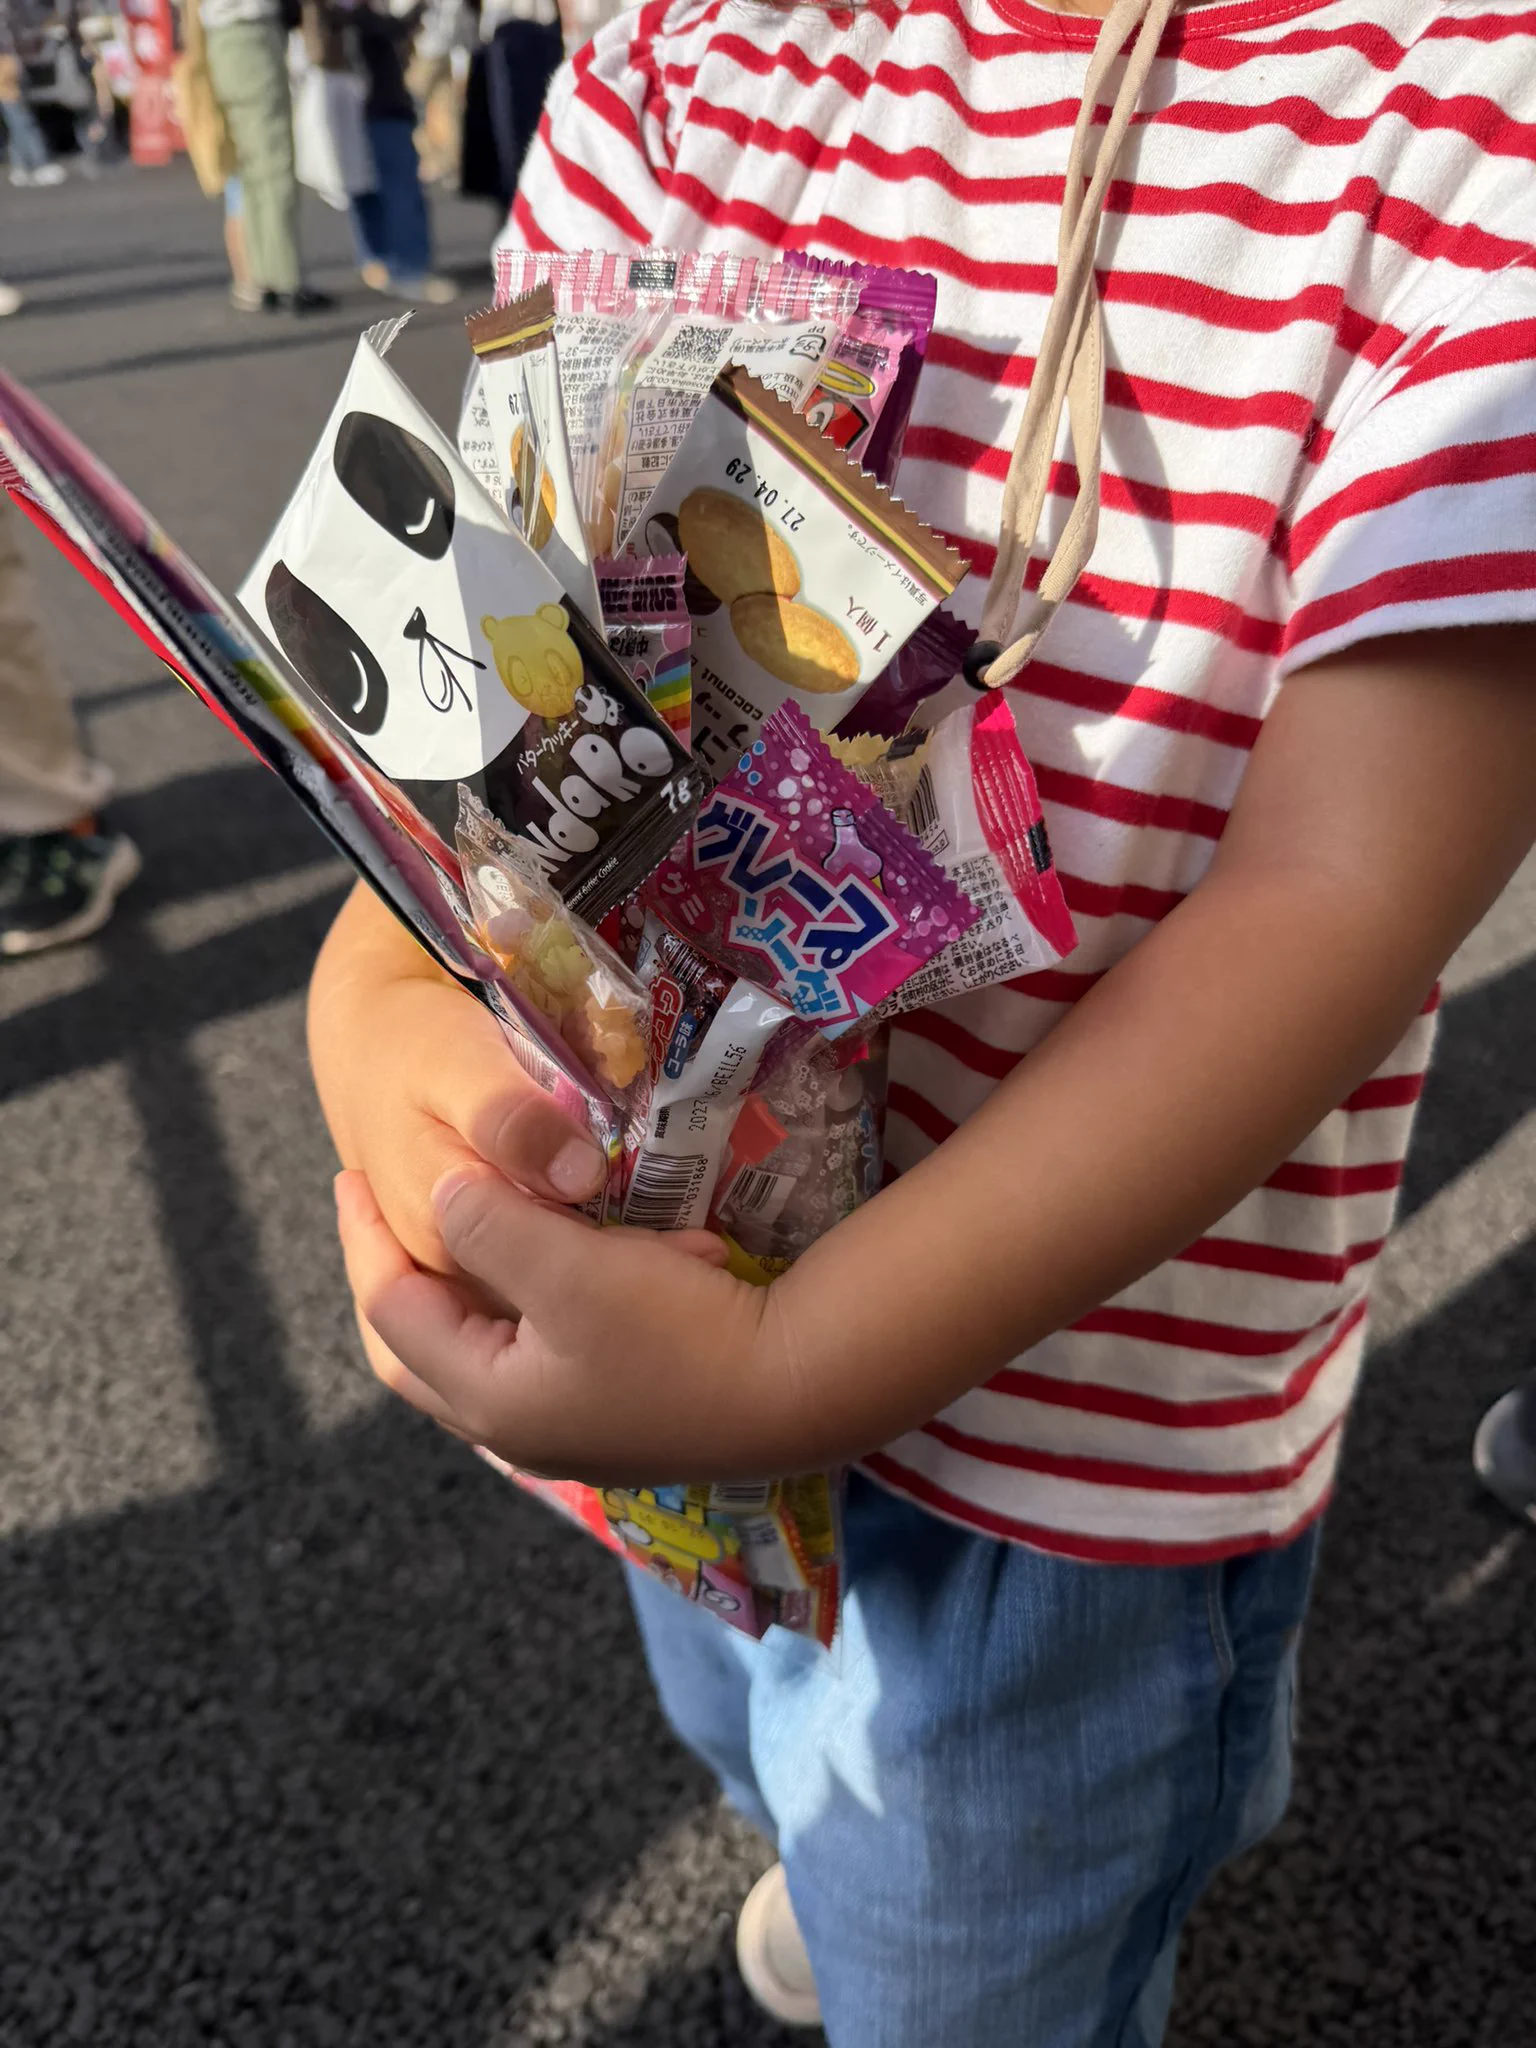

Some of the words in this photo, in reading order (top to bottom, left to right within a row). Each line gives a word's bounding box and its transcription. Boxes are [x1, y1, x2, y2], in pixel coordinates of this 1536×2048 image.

[846, 523, 928, 607] 写真はイメージです。
[515, 718, 579, 776] バタークッキー
[694, 798, 894, 972] グレープ
[666, 1020, 694, 1071] コーラ味
